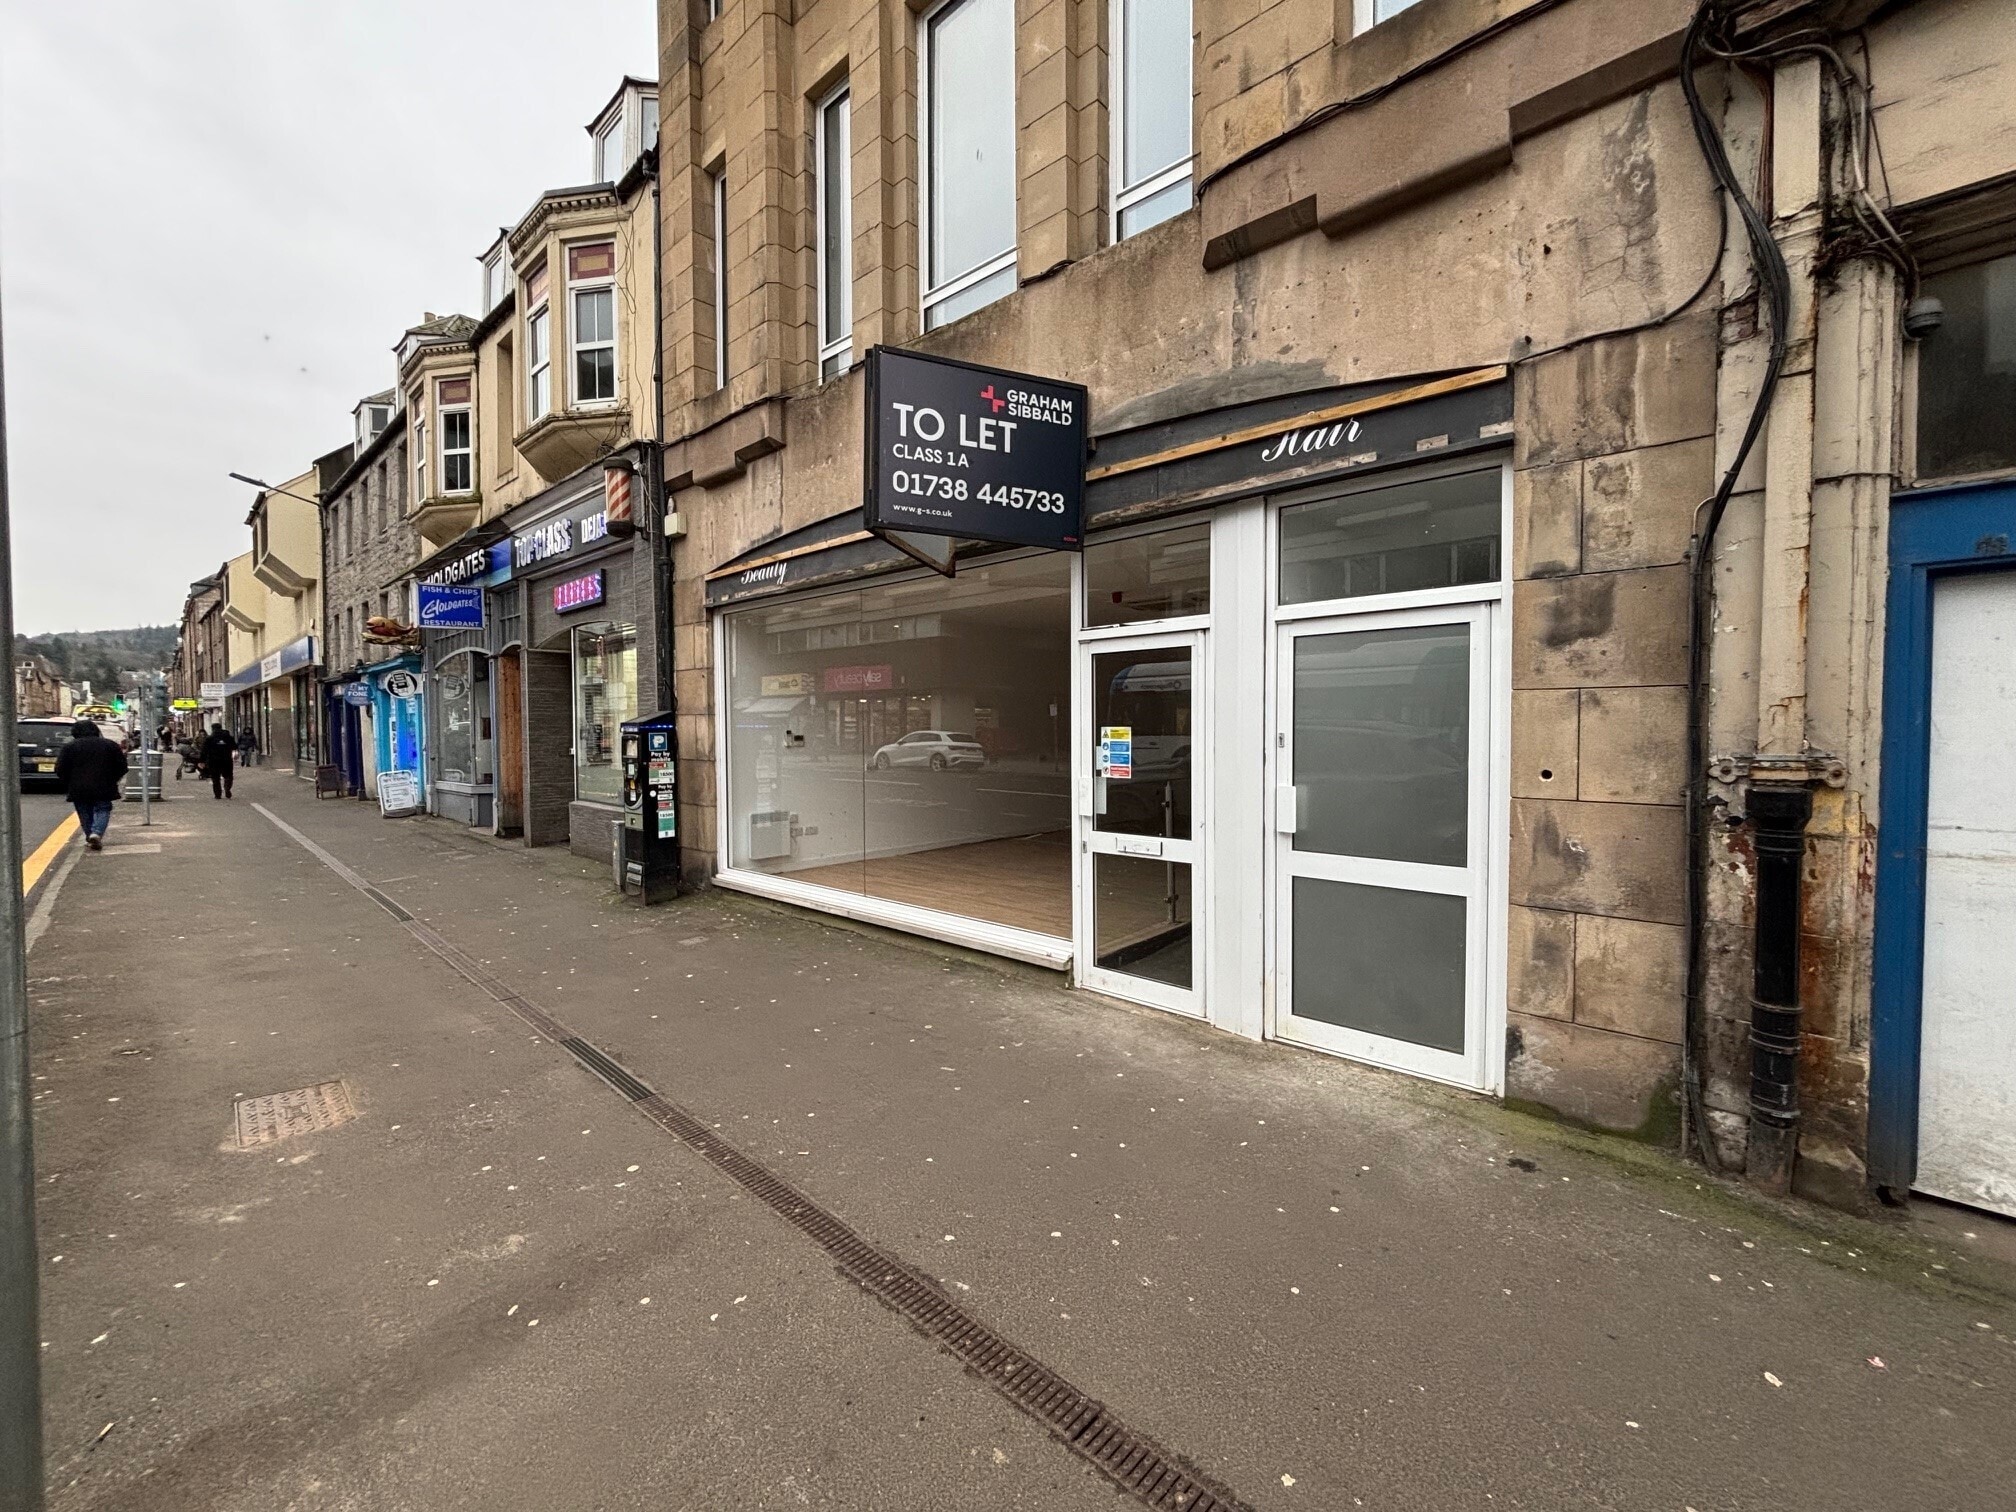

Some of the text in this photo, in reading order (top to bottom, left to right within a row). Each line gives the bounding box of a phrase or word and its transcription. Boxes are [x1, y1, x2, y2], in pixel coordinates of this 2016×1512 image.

[1006, 389, 1073, 413] GRAHAM
[1008, 403, 1073, 426] SIBBALD
[892, 402, 1018, 453] TO LET
[892, 443, 970, 468] CLASS 1A
[892, 470, 1065, 514] 01738 445733
[892, 503, 953, 518] www.g-s.co.uk
[514, 534, 533, 568] TOP
[534, 518, 572, 561] CLASS
[453, 588, 479, 596] CHIPS
[423, 619, 480, 627] RESTAURANT
